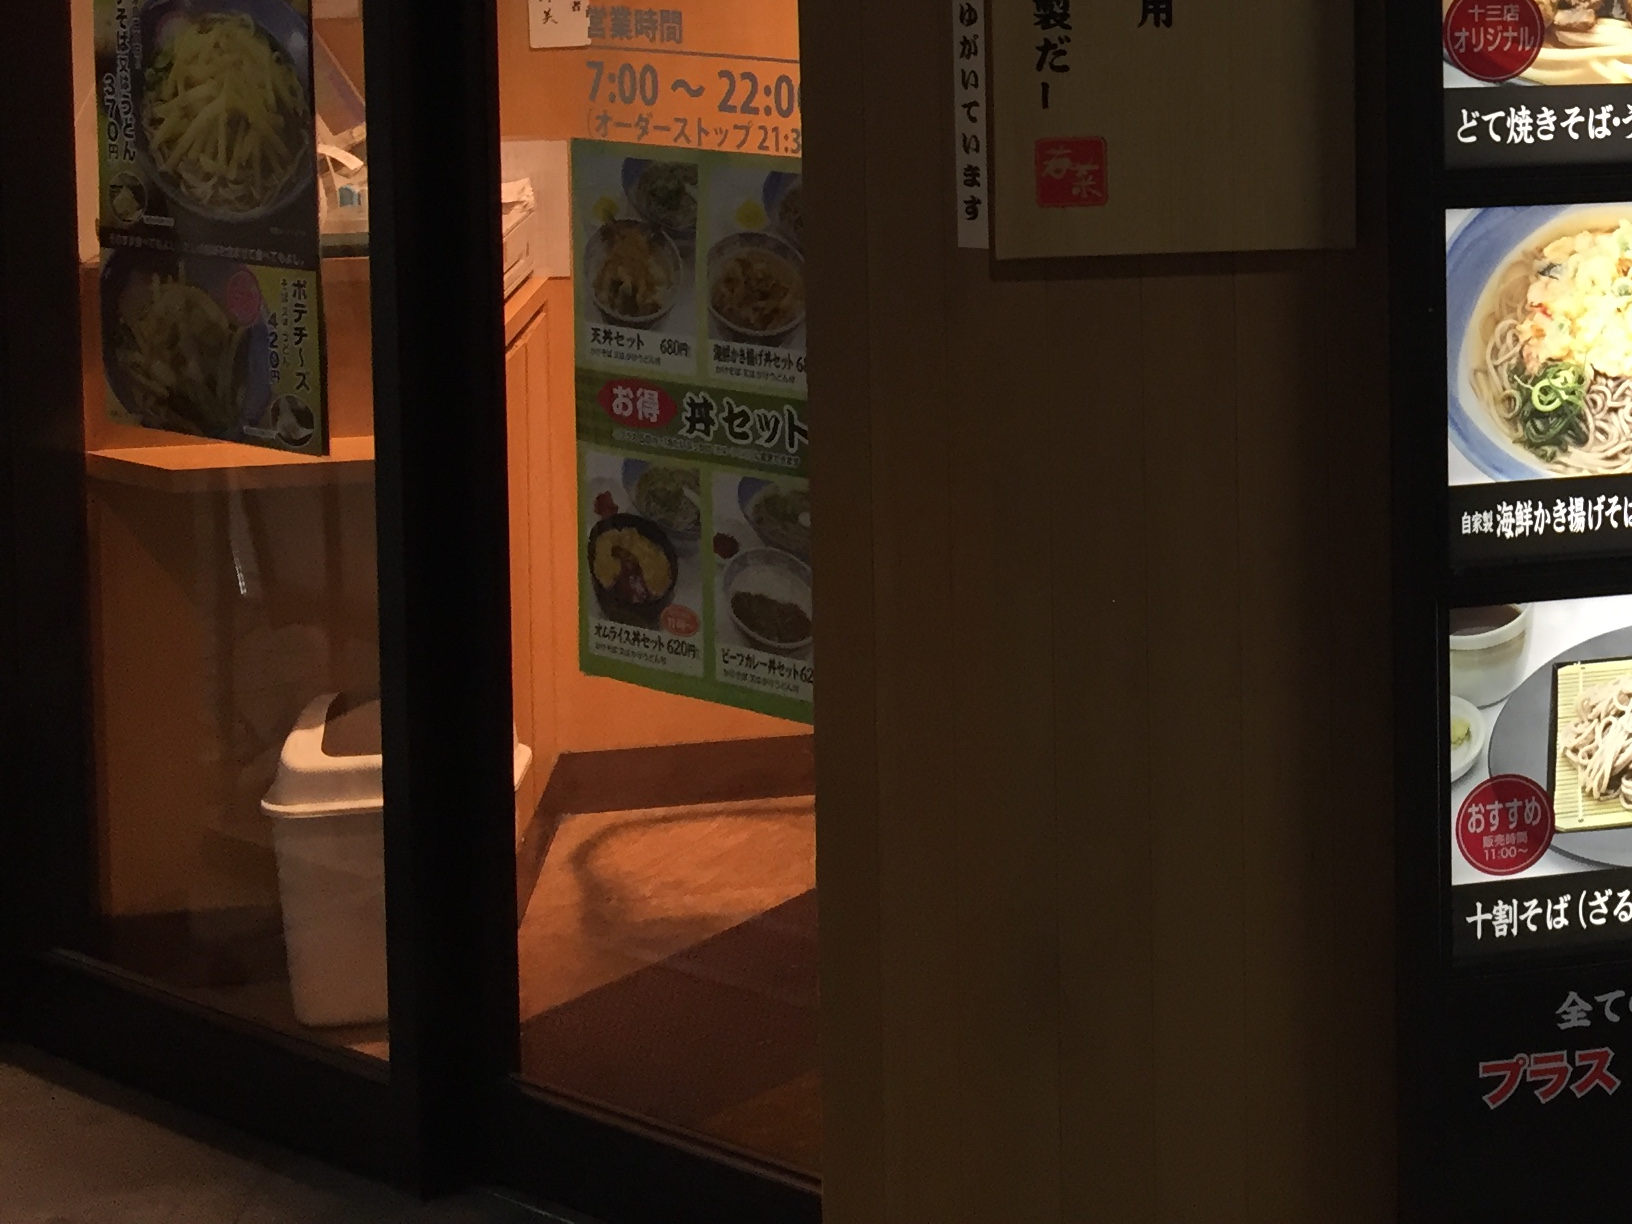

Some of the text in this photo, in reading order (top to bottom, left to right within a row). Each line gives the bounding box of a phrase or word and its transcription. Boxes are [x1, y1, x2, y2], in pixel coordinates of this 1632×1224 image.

[586, 5, 684, 45] 営業時間
[1468, 4, 1520, 23] 十三店
[1454, 26, 1536, 54] オリジナル
[612, 385, 661, 423] お得
[1466, 795, 1542, 834] おすすめ
[1482, 832, 1529, 849] 販売時間
